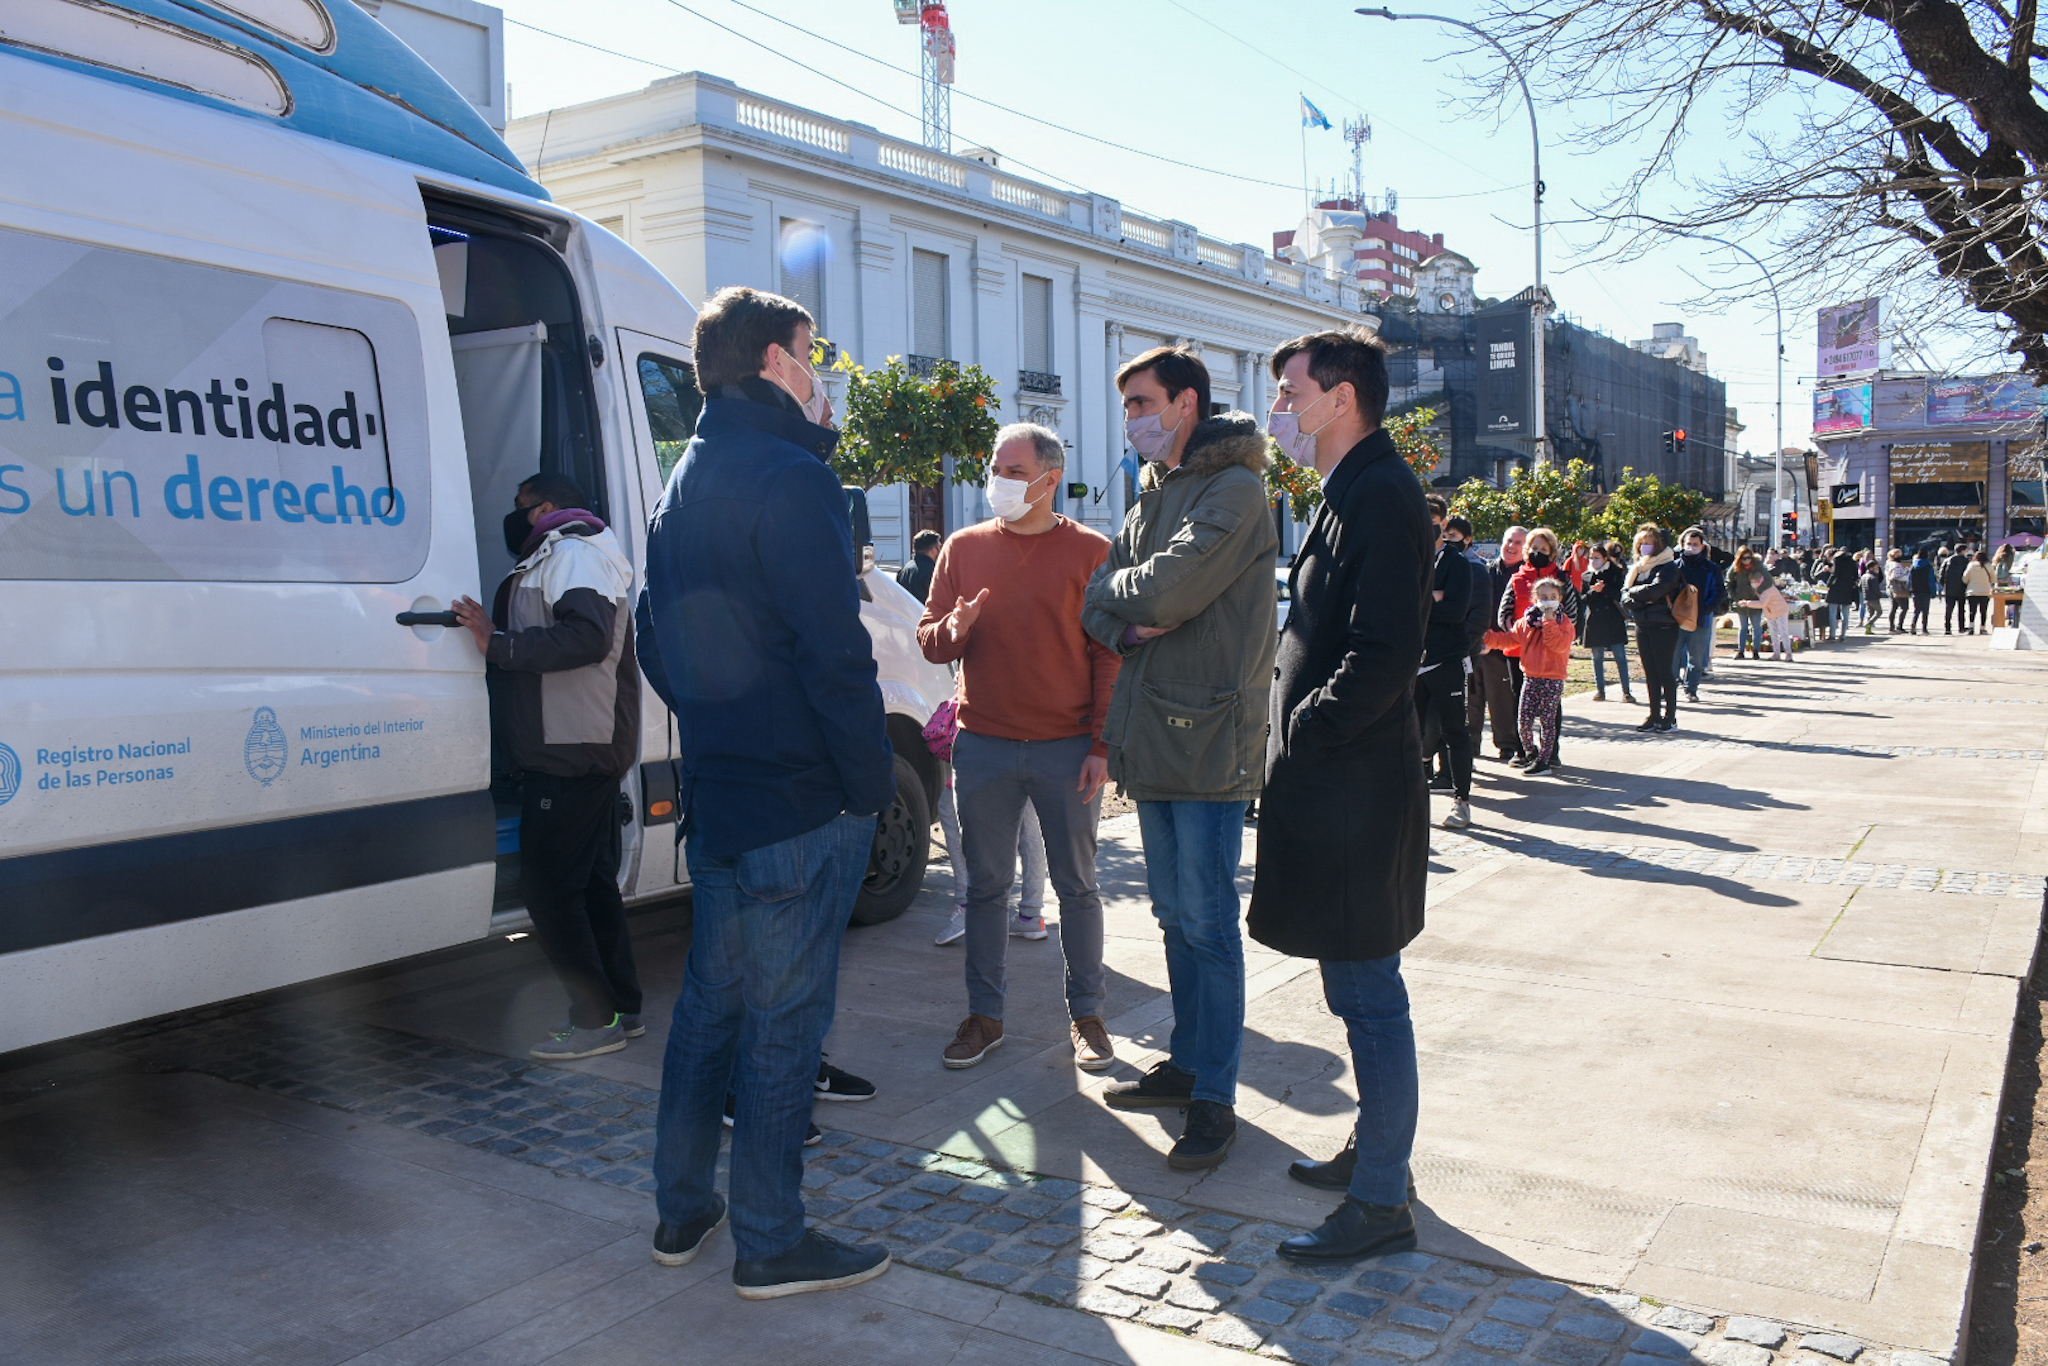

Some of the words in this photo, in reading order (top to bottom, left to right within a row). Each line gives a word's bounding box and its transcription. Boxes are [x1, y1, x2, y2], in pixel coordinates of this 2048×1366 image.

[1490, 342, 1515, 353] TANDIL
[1490, 359, 1515, 370] LIMPIA
[55, 467, 140, 518] un
[163, 454, 406, 526] derecho
[300, 723, 361, 740] Ministerio
[363, 720, 381, 736] del
[384, 718, 425, 734] Interior
[37, 745, 114, 767] Registro
[118, 737, 191, 759] Nacional
[300, 742, 381, 768] Argentina
[37, 773, 61, 790] de
[66, 770, 91, 788] las
[96, 767, 175, 786] Personas
